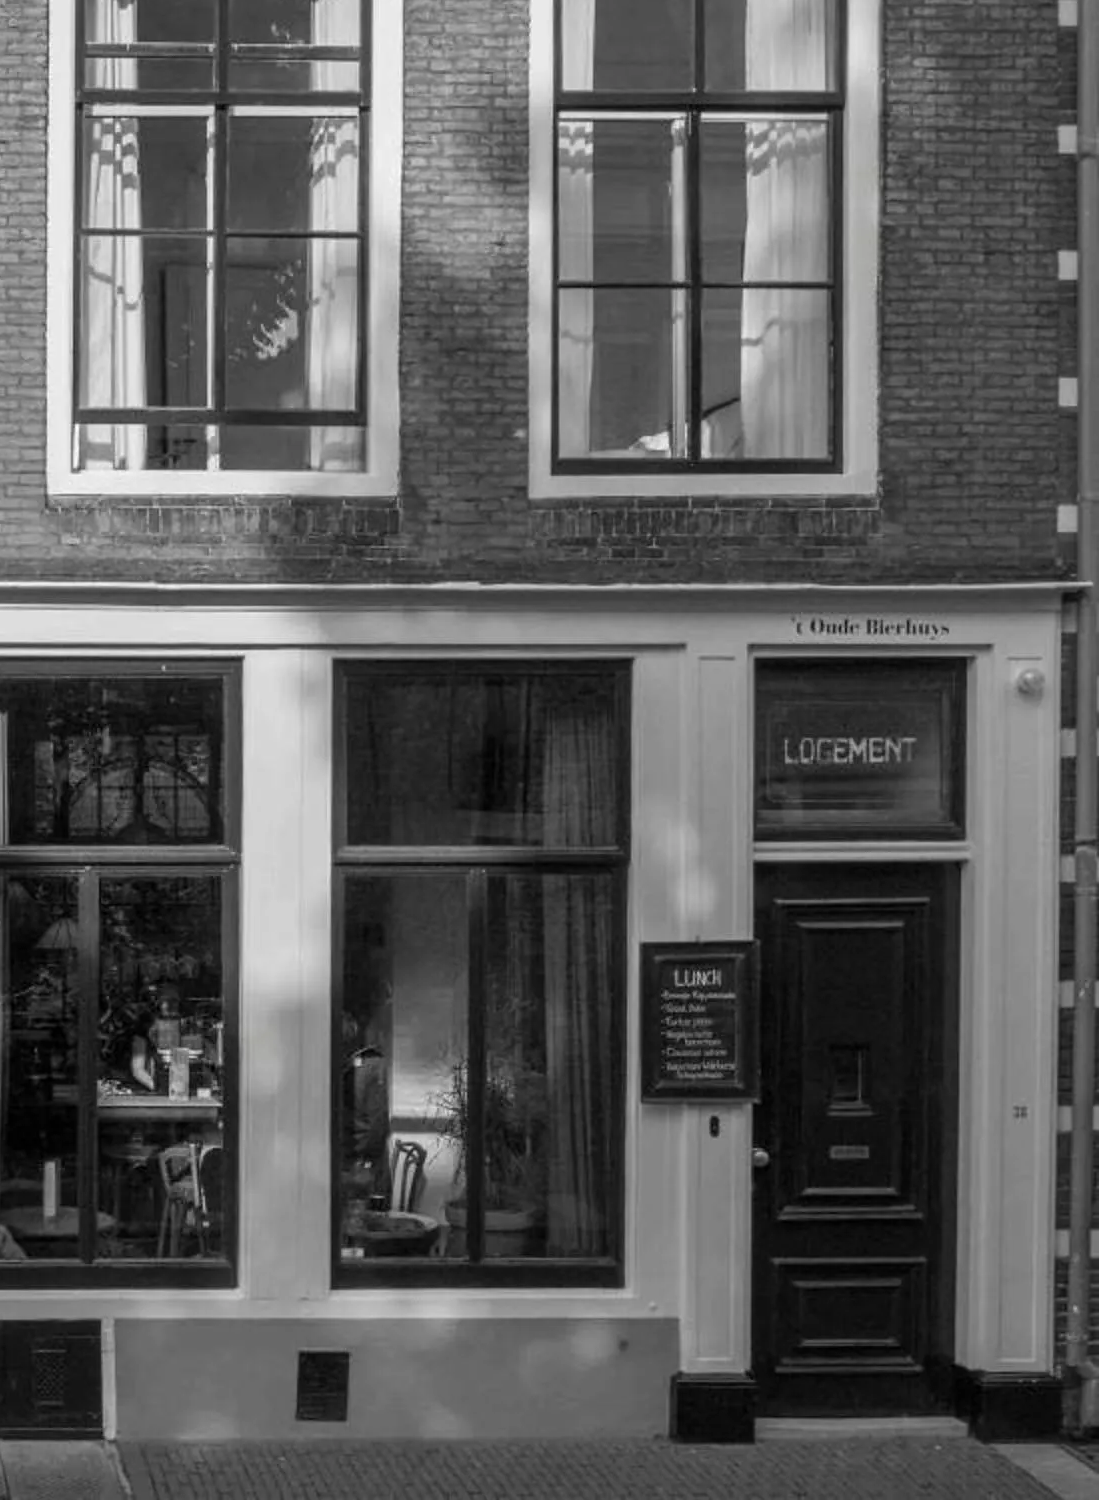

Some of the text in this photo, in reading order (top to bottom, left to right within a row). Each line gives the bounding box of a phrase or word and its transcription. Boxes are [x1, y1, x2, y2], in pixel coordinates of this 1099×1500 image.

[809, 617, 860, 635] Oude
[865, 617, 951, 641] Bierhuys
[783, 736, 918, 765] LOGEMENT
[673, 968, 723, 988] LUNCH
